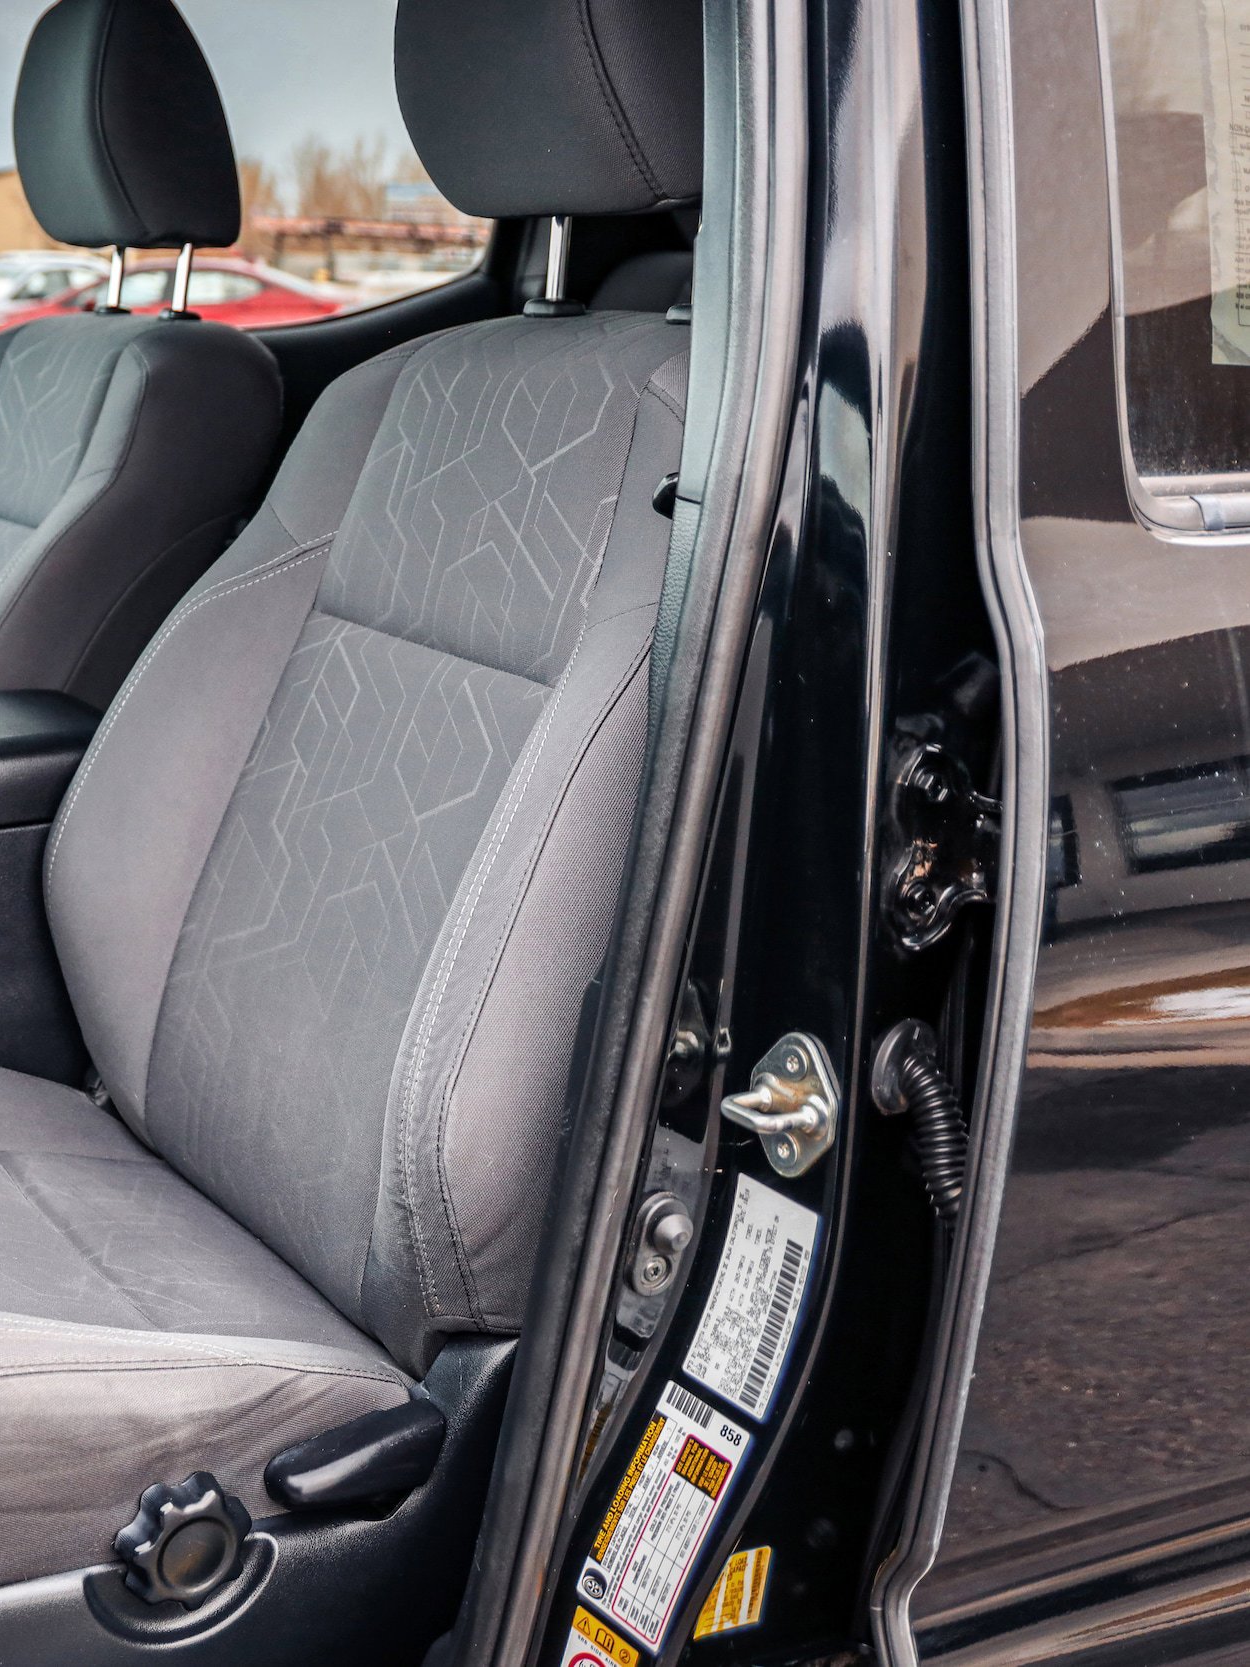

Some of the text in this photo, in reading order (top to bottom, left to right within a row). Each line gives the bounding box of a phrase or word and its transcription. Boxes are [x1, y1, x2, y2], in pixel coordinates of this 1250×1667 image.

[720, 1424, 742, 1446] 858
[636, 1461, 644, 1470] ET
[640, 1454, 647, 1463] LE
[593, 1528, 606, 1547] TIRE
[601, 1511, 614, 1530] AND
[610, 1475, 631, 1512] LOADING
[626, 1420, 657, 1476] INFORMATION
